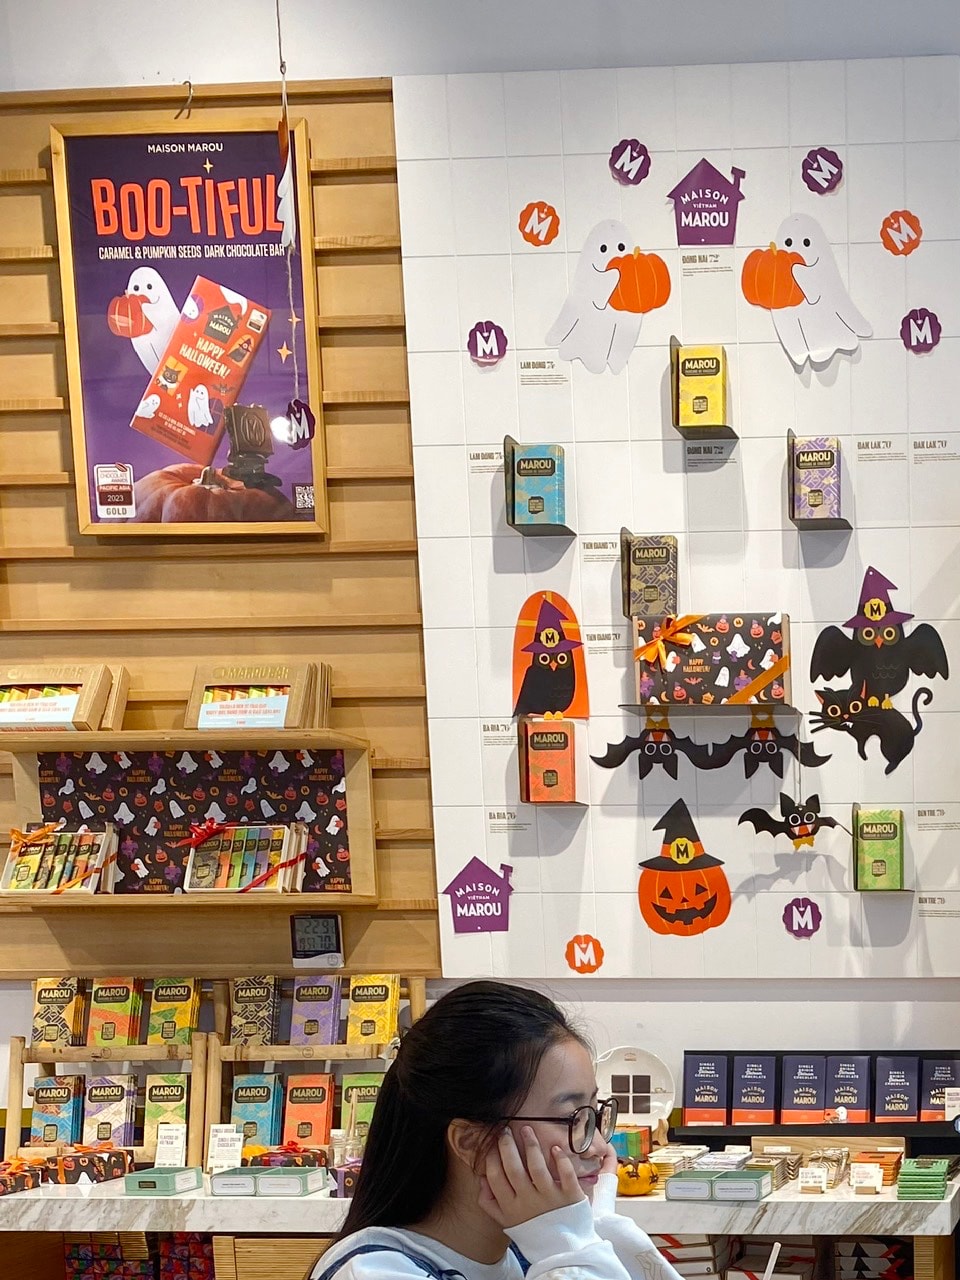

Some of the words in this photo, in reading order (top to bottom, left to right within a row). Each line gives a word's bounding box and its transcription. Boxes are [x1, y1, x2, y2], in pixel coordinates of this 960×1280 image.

[148, 143, 185, 153] MAISON
[187, 142, 223, 152] MAROU
[614, 145, 645, 180] M
[807, 154, 839, 189] M
[680, 189, 729, 205] MAISON
[90, 174, 283, 241] BOO-TIFUL
[525, 207, 552, 241] M
[681, 211, 729, 227] MAROU
[886, 216, 918, 250] M
[99, 246, 134, 260] CARAMEL
[134, 246, 142, 258] &
[143, 246, 176, 259] PUMPKIN
[178, 246, 201, 258] SEEDS
[204, 245, 225, 257] DARK
[226, 245, 268, 257] CHOCOLATE
[269, 244, 285, 256] BAR
[208, 321, 233, 336] MAROU
[909, 316, 933, 346] M
[196, 337, 226, 360] HAPPY
[476, 329, 499, 357] M
[179, 345, 232, 380] HALLOWEEN!
[685, 359, 717, 370] MAROU
[800, 452, 831, 463] MAROU
[520, 459, 552, 470] MAROU
[106, 508, 127, 516] GOLD
[636, 548, 666, 558] MAROU
[870, 603, 882, 617] M
[545, 632, 556, 643] M
[533, 733, 565, 743] MAROU
[863, 824, 894, 833] MAROU
[676, 843, 690, 859] M
[455, 882, 500, 898] MAISON
[456, 902, 501, 917] MAROU
[792, 905, 814, 931] M
[573, 941, 596, 967] M
[41, 989, 71, 998] MAROU
[98, 988, 127, 997] MAROU
[158, 987, 188, 996] MAROU
[238, 987, 267, 998] MAROU
[300, 987, 329, 996] MAROU
[355, 986, 386, 996] MAROU
[38, 1088, 68, 1098] MAROU
[92, 1086, 121, 1096] MAROU
[152, 1086, 182, 1096] MAROU
[238, 1088, 267, 1097] MAROU
[293, 1088, 323, 1097] MAROU
[695, 1095, 718, 1103] MAROU
[741, 1096, 765, 1104] MAROU
[793, 1096, 817, 1105] MAROU
[834, 1095, 857, 1104] MAROU
[930, 1096, 945, 1105] MAR
[885, 1103, 908, 1111] MAROU
